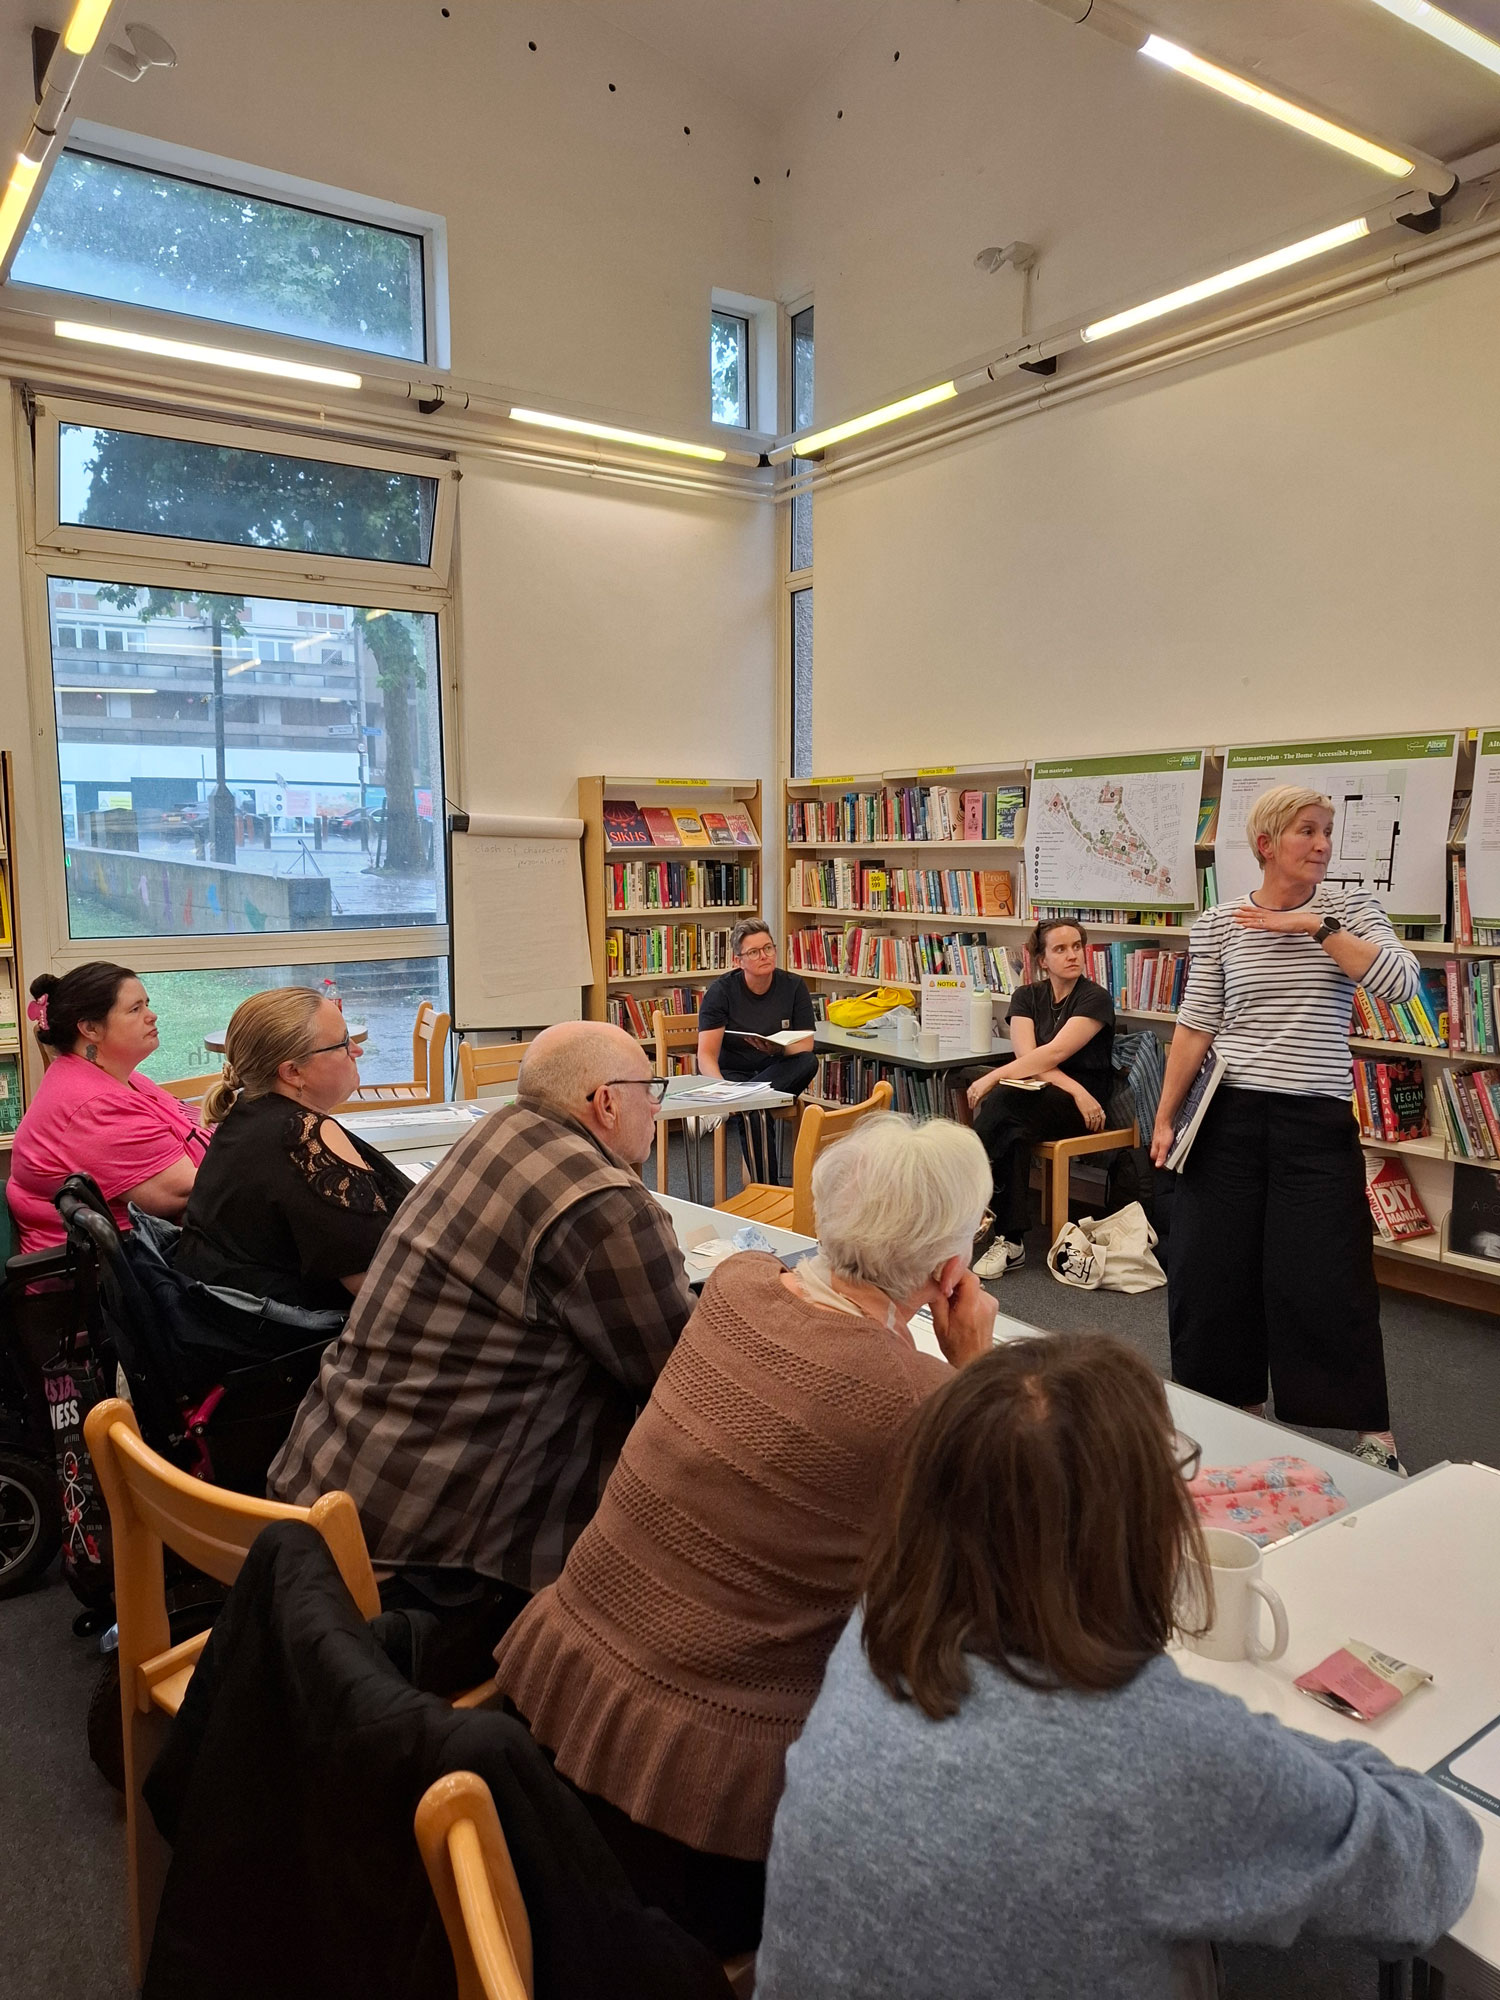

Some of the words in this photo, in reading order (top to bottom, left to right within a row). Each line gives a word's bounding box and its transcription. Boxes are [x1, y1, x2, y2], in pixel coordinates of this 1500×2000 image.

[1426, 739, 1447, 748] Alton
[1248, 754, 1279, 762] masterplan
[1317, 750, 1349, 758] Accessible
[1349, 749, 1372, 757] layouts
[1049, 766, 1073, 774] masterplan
[609, 831, 647, 843] SIKHS
[475, 843, 501, 853] clash
[507, 843, 518, 856] of
[523, 844, 569, 854] characters
[984, 873, 1009, 882] Proof
[1481, 973, 1489, 997] FACIAL
[1483, 997, 1492, 1036] EXPRESSION
[1369, 1089, 1378, 1117] LEVANT
[1380, 1077, 1392, 1125] VEGAN
[1393, 1090, 1424, 1103] VEGAN
[1372, 1181, 1394, 1189] READER'S
[1394, 1178, 1409, 1186] DIGEST
[1375, 1184, 1416, 1214] DIY
[1386, 1208, 1426, 1224] MANUAL
[1439, 1773, 1458, 1787] Alton
[1458, 1783, 1500, 1809] Masterplan
